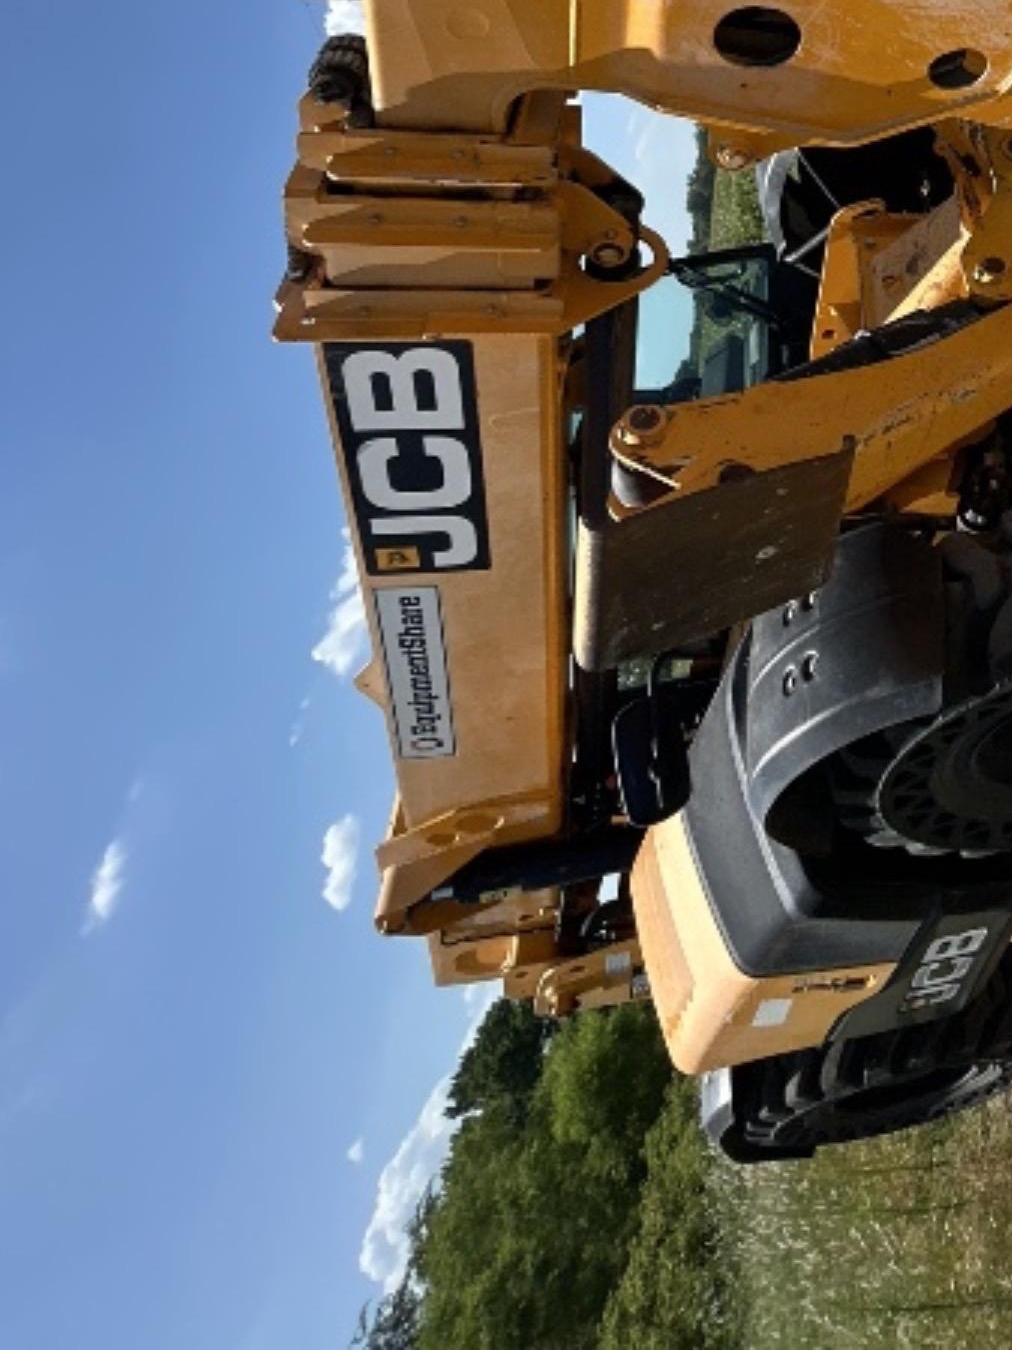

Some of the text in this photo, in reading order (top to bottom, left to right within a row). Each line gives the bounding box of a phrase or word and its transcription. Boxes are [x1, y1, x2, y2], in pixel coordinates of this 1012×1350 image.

[341, 347, 479, 569] JCB
[399, 594, 443, 736] EquipmentShare
[905, 926, 988, 1006] JCB
